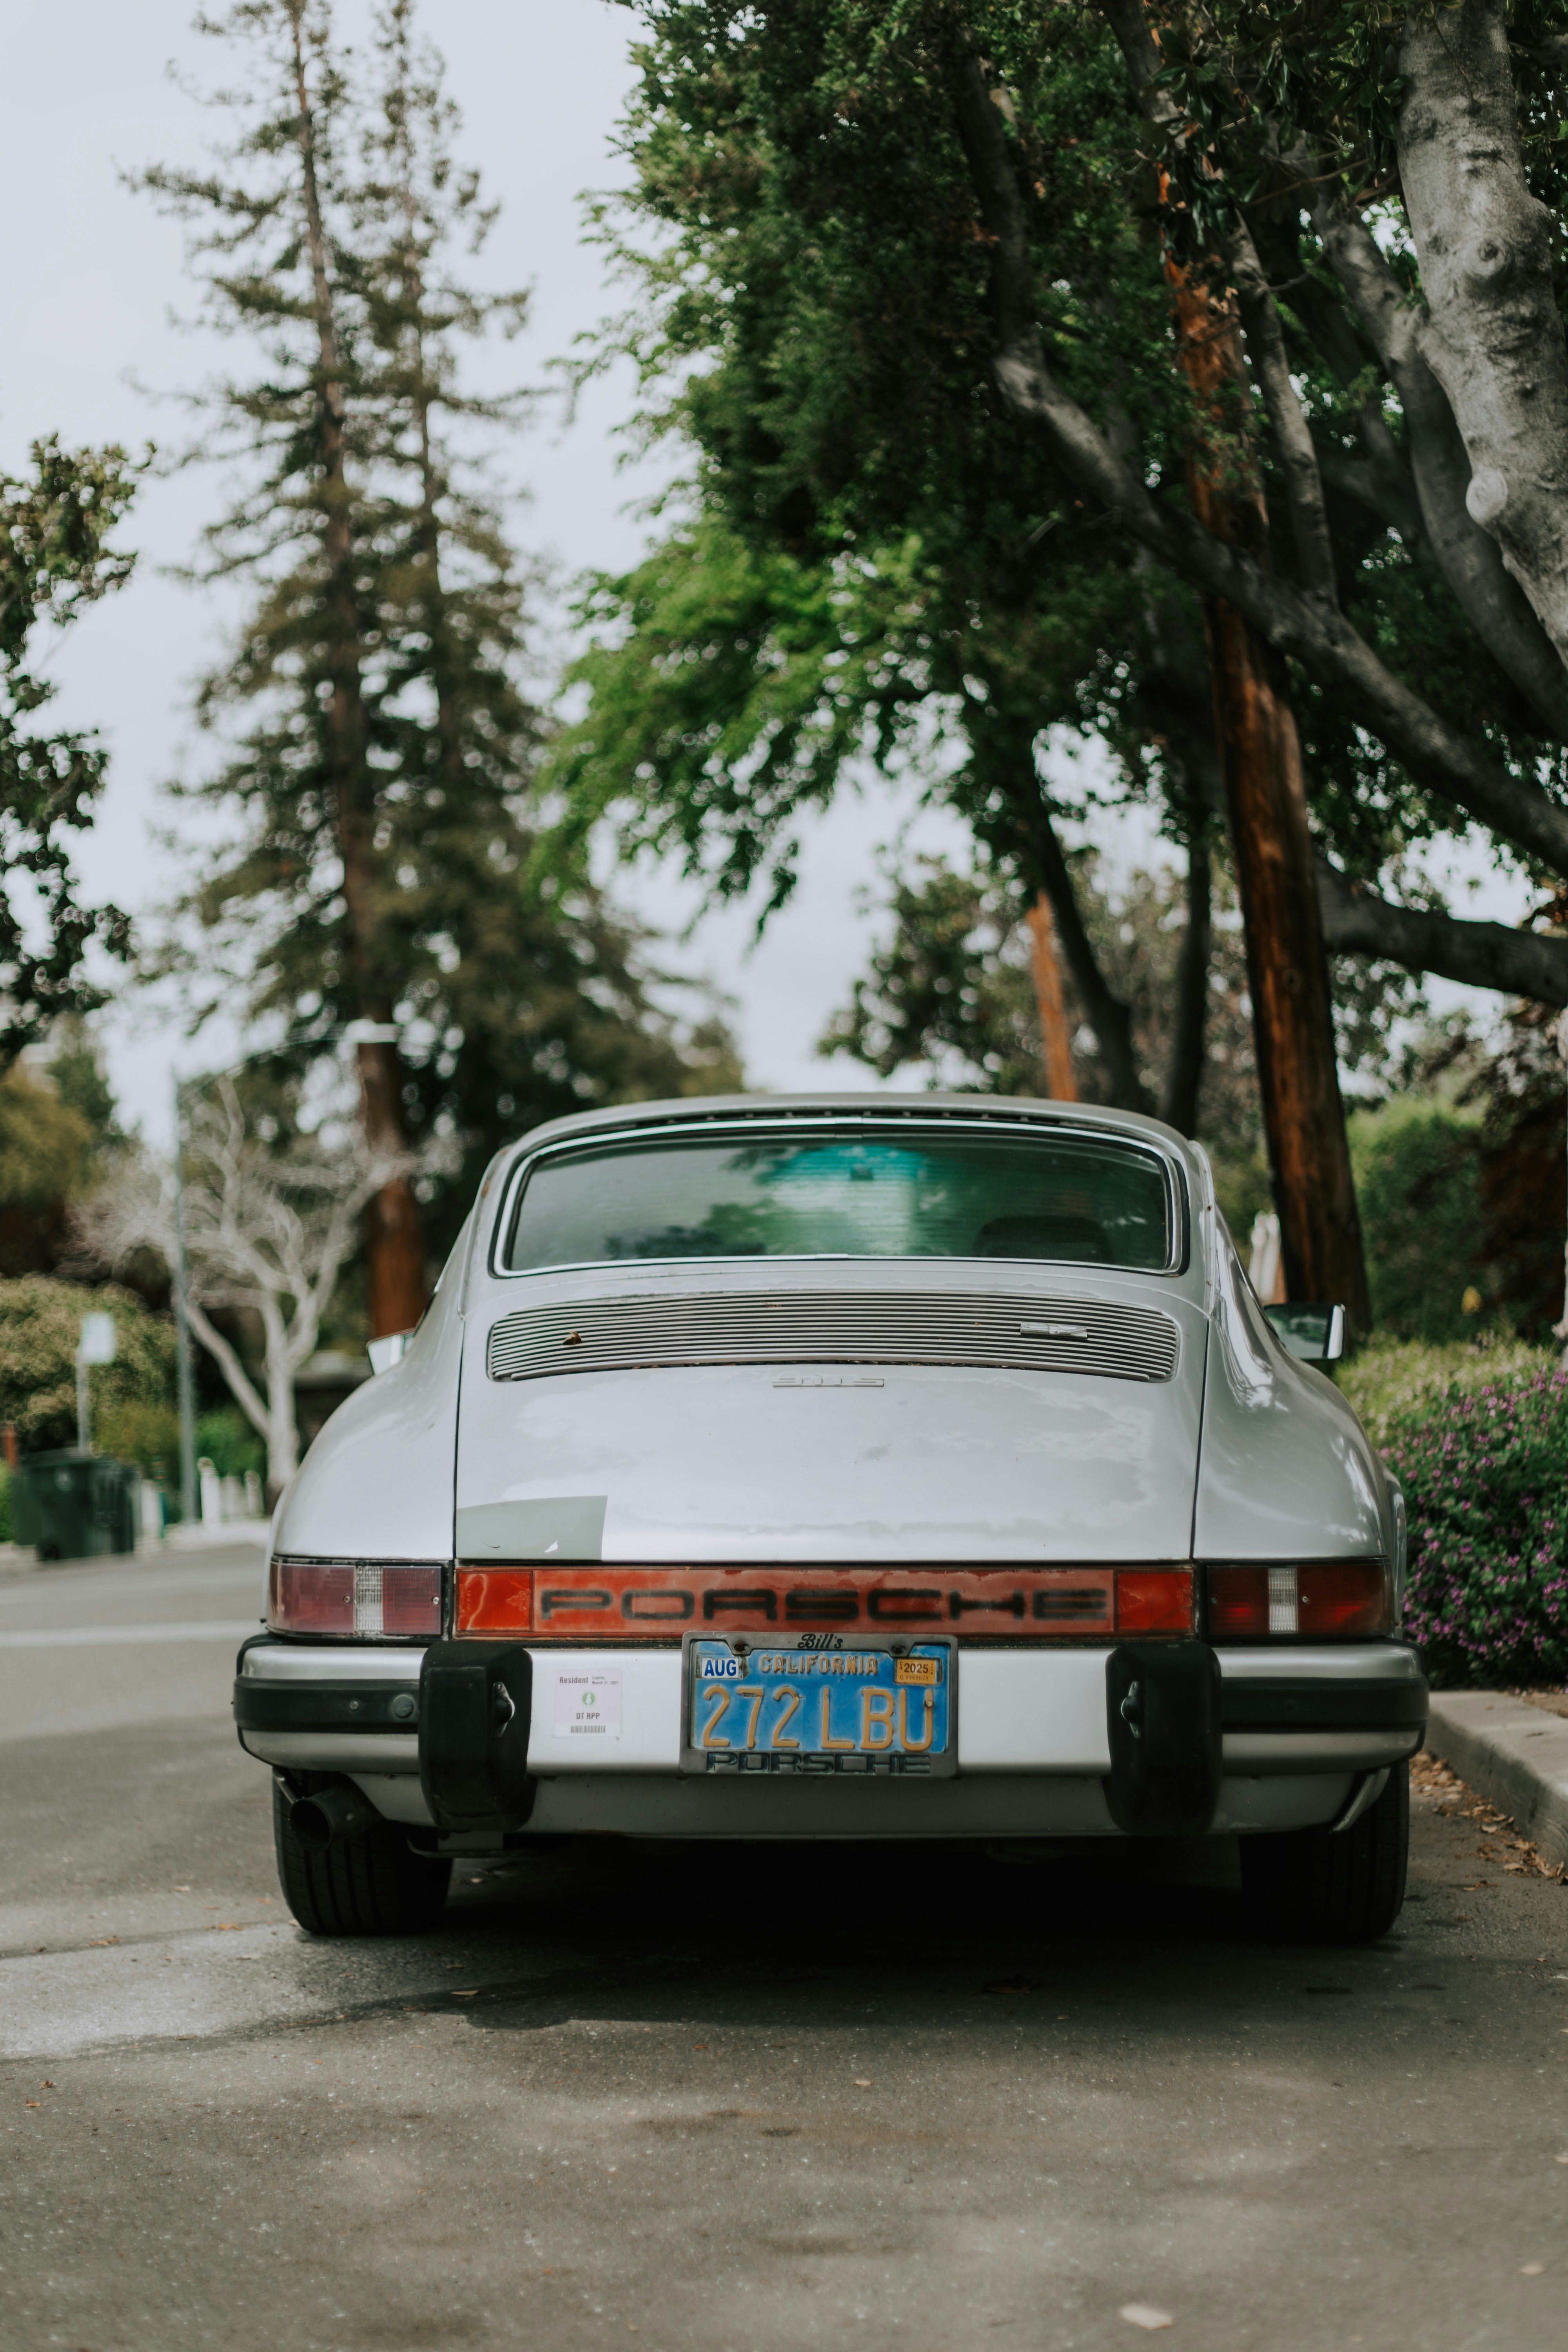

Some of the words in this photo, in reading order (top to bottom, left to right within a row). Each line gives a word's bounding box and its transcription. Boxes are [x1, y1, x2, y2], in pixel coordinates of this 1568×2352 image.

[541, 1588, 1107, 1621] PORSCHE
[797, 1633, 843, 1649] Bill's
[704, 1659, 737, 1677] AUG
[760, 1654, 878, 1674] CALIFORNIA
[904, 1663, 929, 1673] 2025
[702, 1685, 800, 1748] 272
[821, 1687, 933, 1751] LBU
[706, 1751, 931, 1776] PORSCHE
